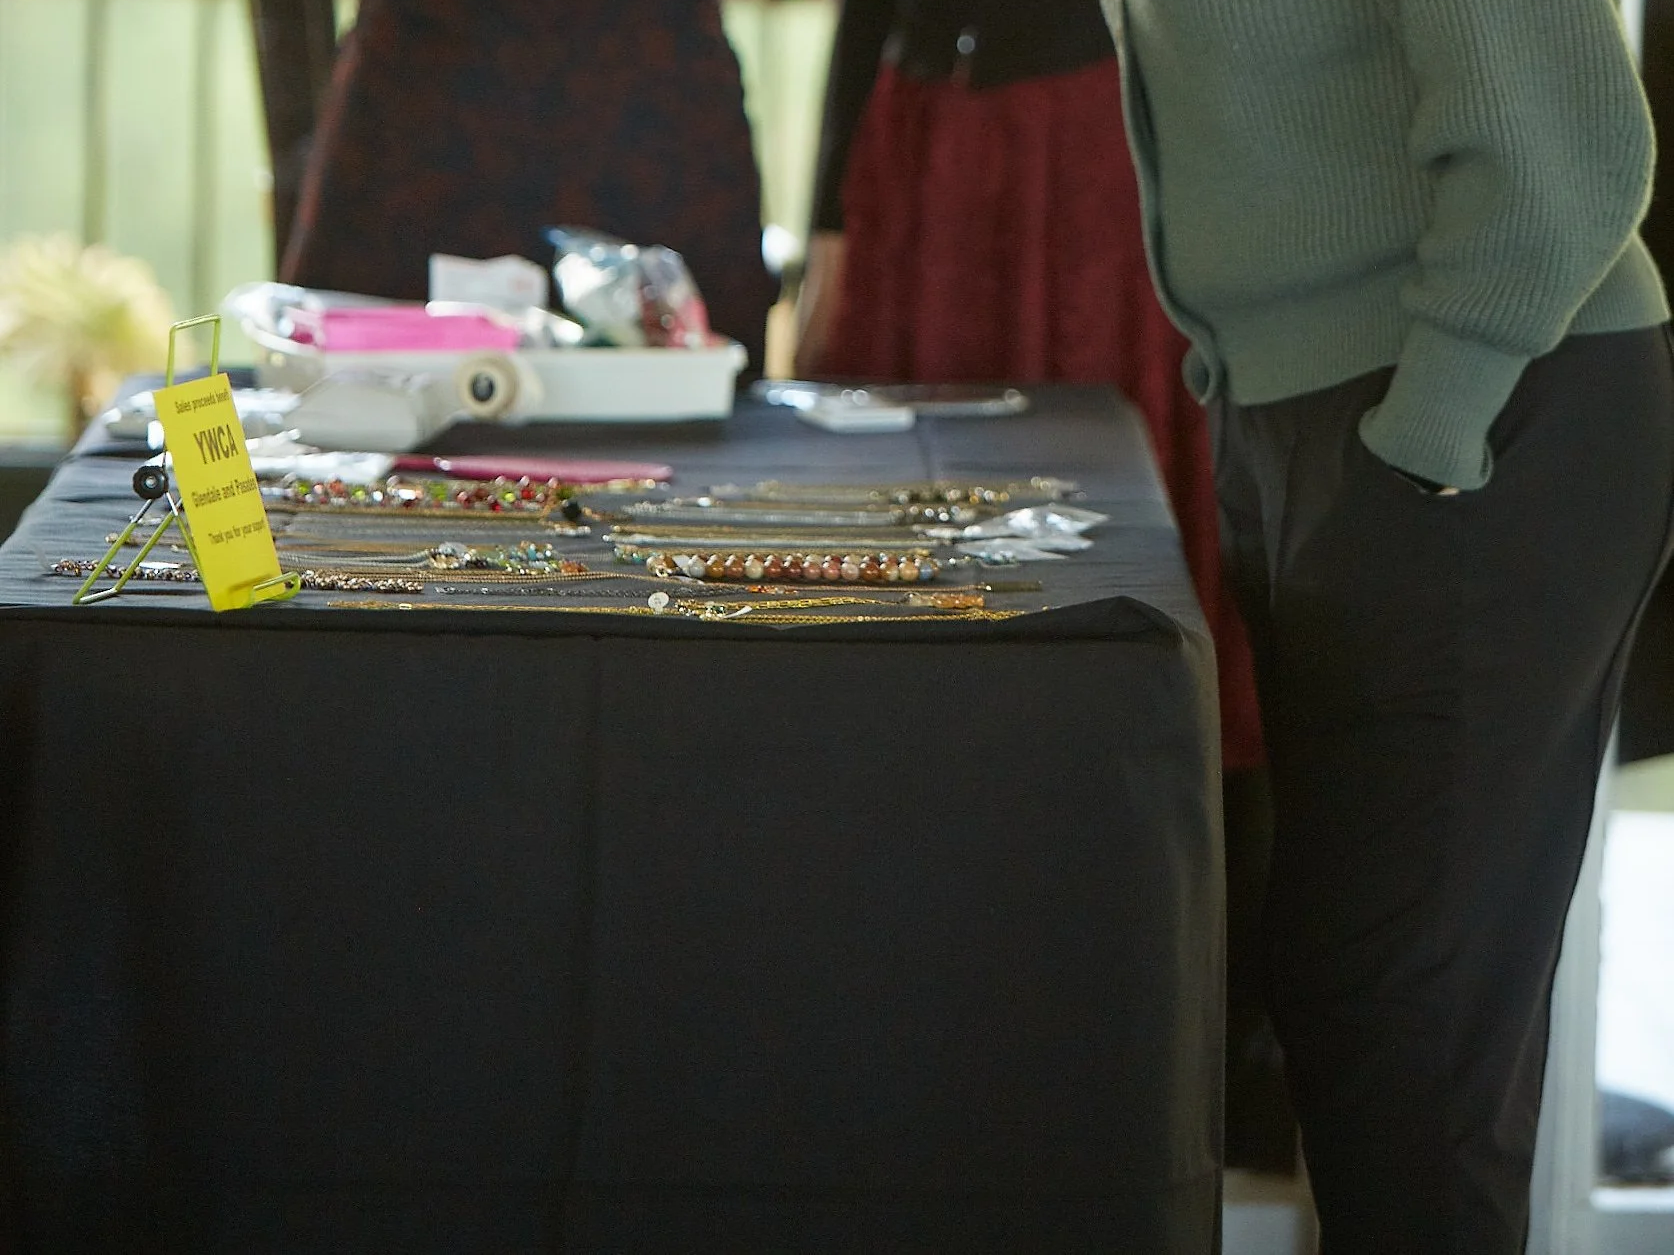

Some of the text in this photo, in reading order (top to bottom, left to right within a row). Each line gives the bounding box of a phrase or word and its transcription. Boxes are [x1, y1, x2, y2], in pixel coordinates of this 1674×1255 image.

[174, 401, 192, 414] Sales
[193, 424, 239, 464] YWCA
[221, 480, 236, 499] and
